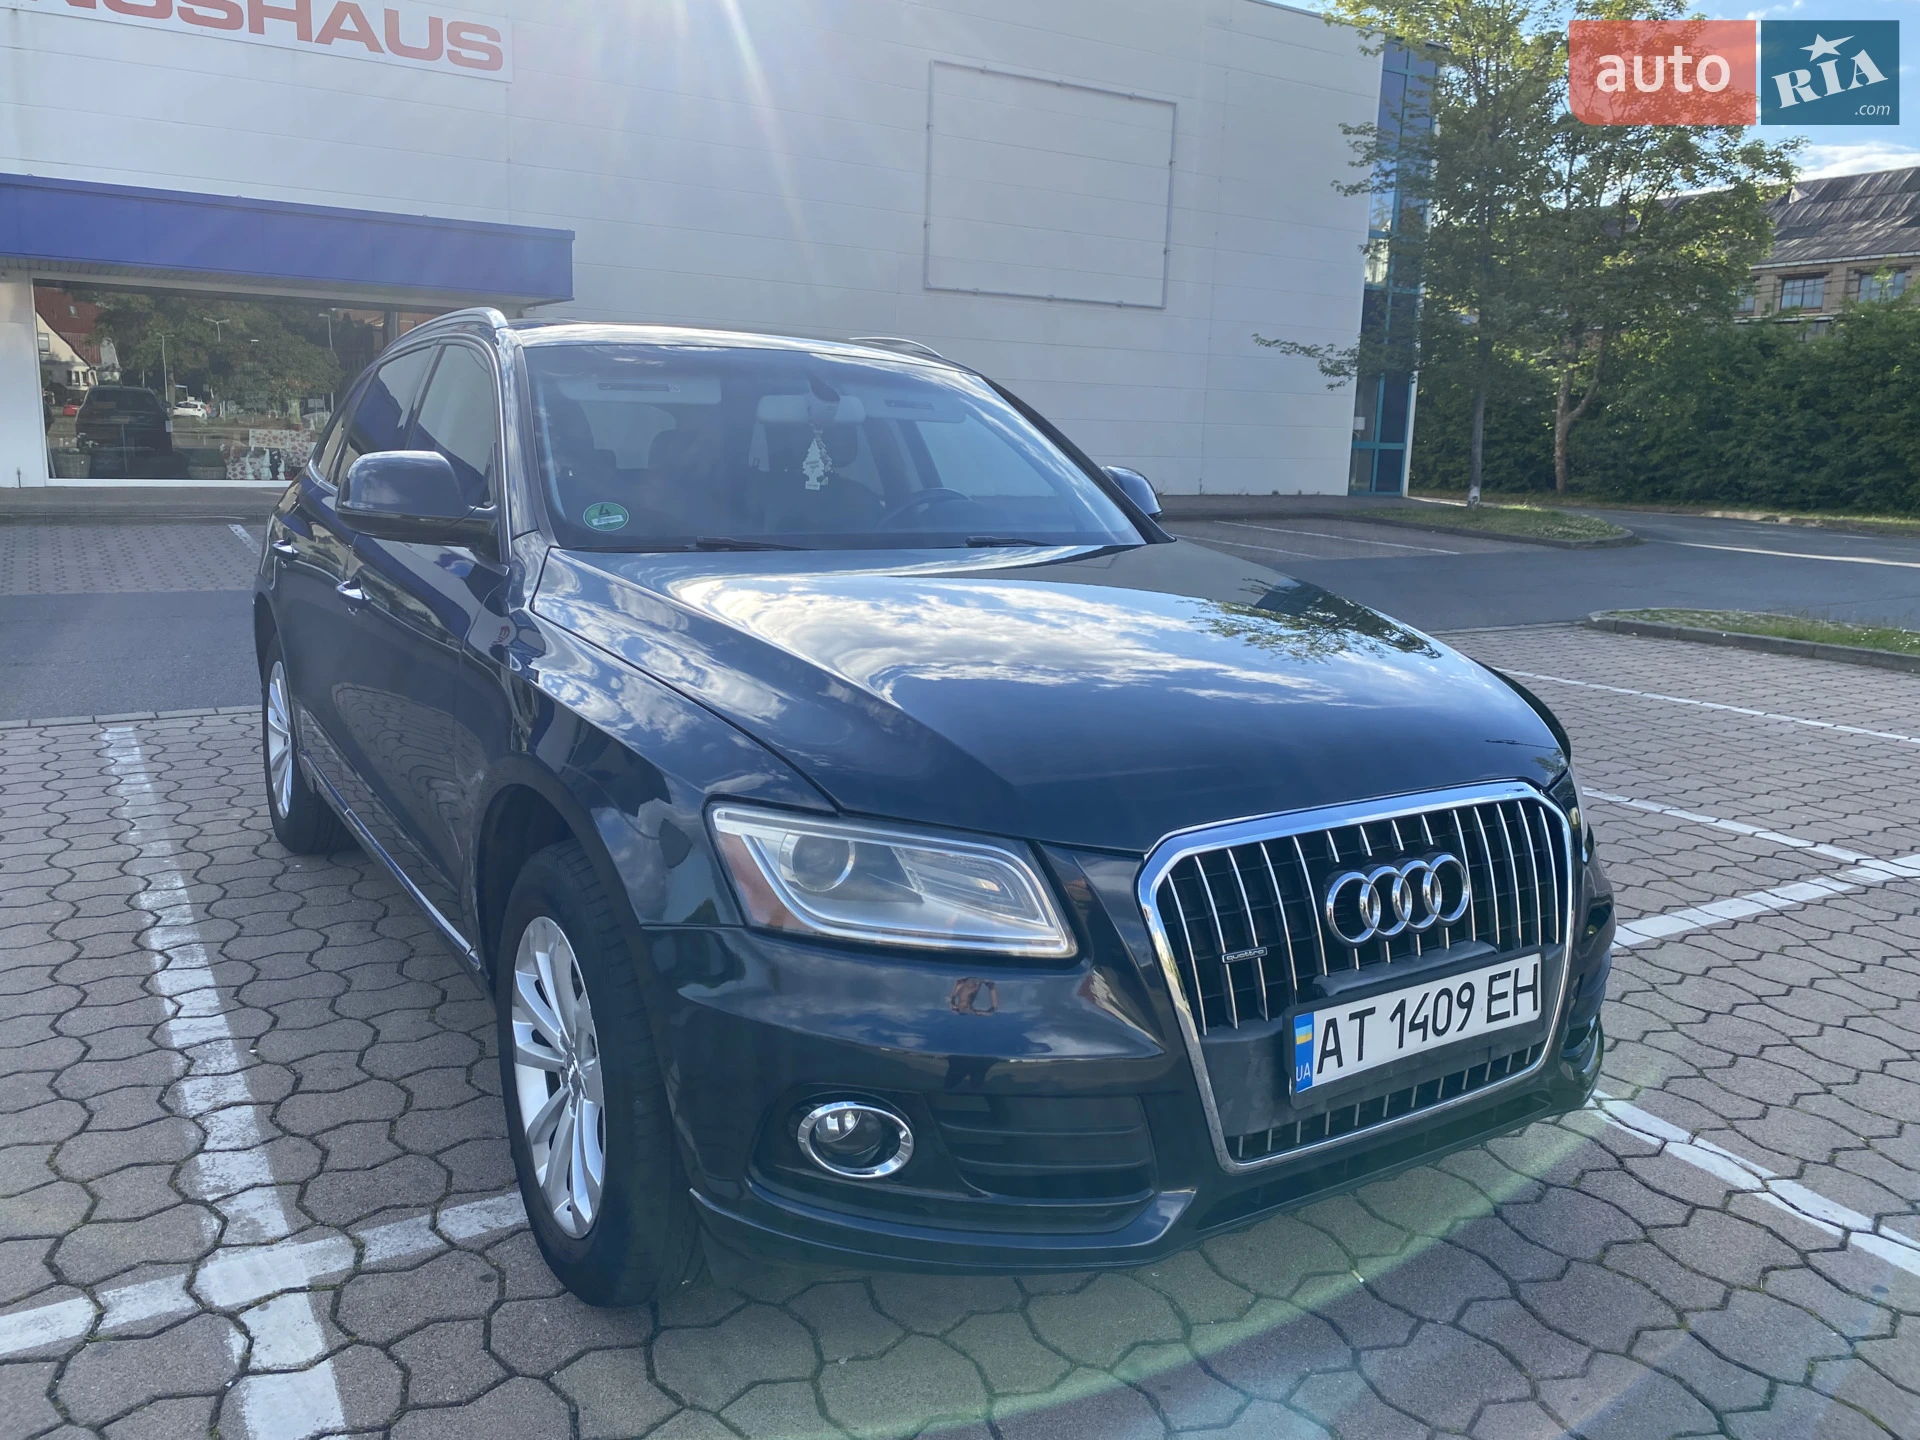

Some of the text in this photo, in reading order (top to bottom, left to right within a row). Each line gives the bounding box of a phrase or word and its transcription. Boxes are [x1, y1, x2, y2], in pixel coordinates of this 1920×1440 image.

[1226, 949, 1265, 962] quattro
[1316, 962, 1539, 1075] AT 1409 EH
[1296, 1062, 1311, 1082] UA
